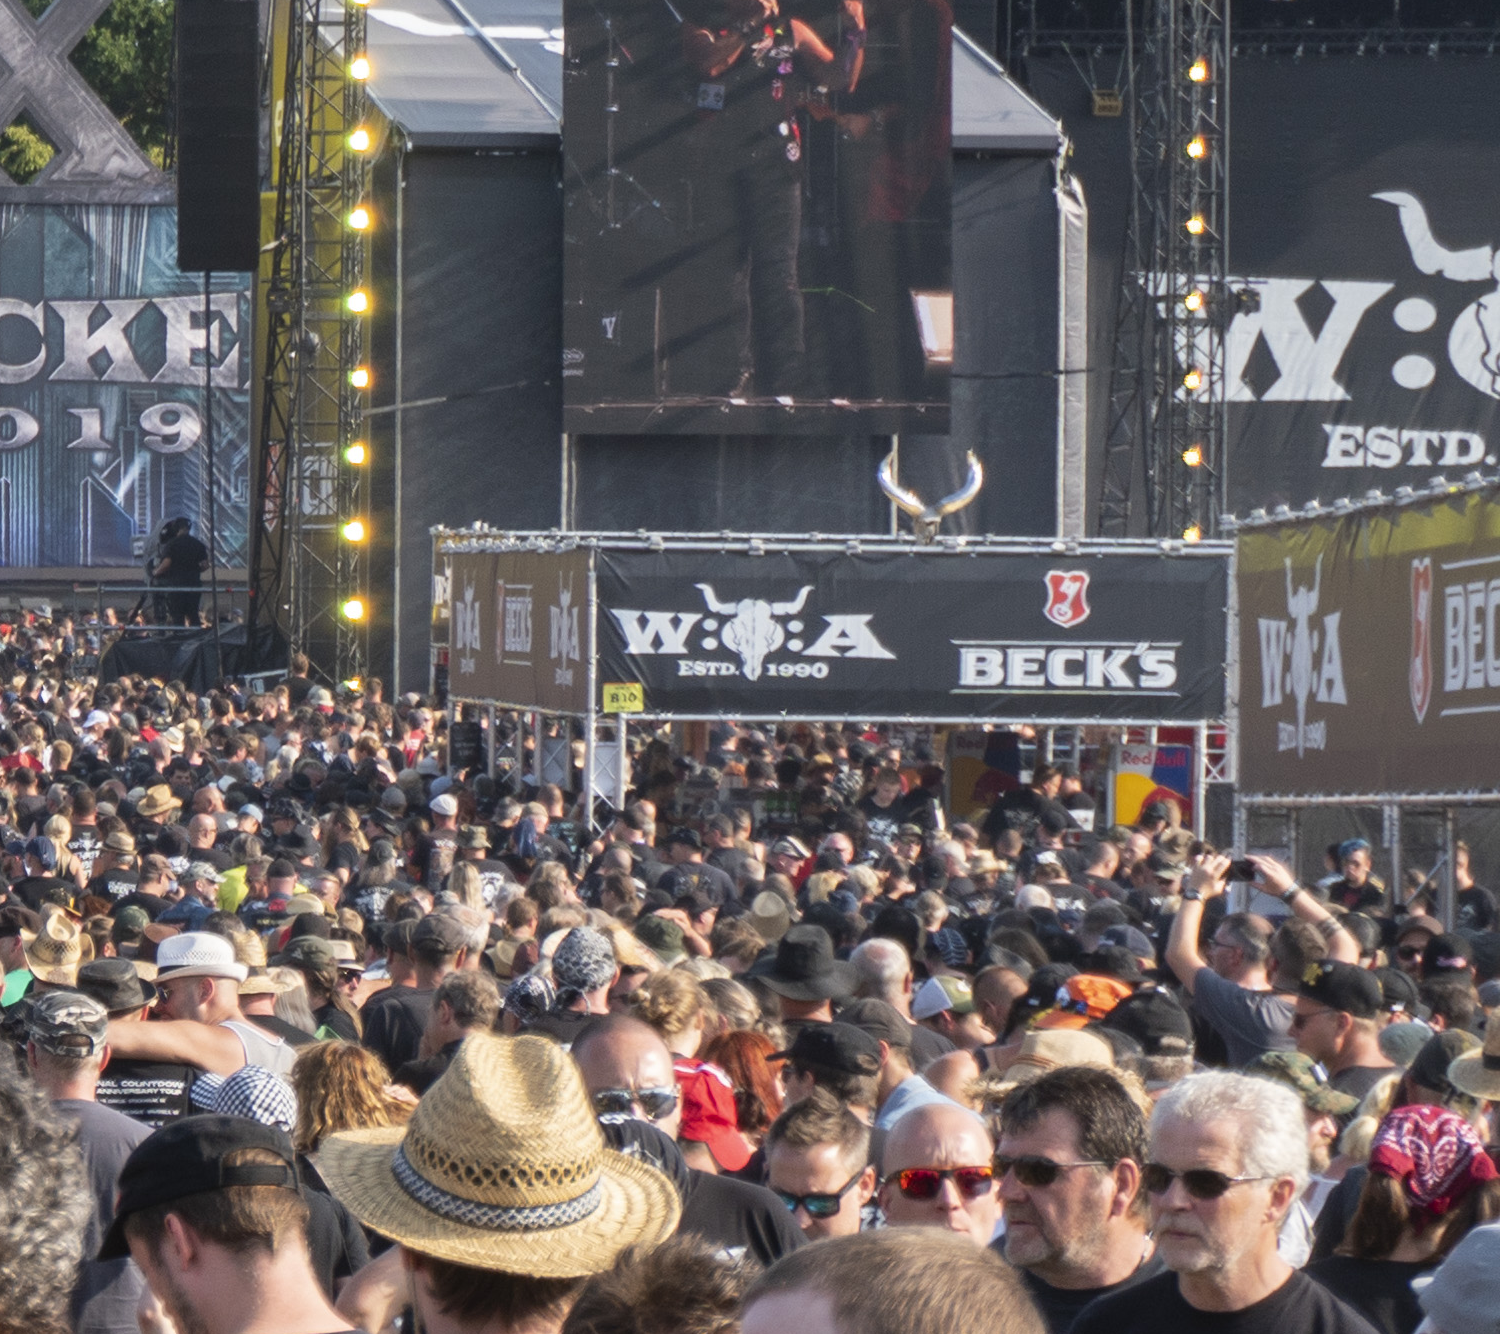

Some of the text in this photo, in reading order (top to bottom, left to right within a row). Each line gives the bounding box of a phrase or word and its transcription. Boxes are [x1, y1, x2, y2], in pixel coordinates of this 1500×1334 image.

[1321, 423, 1498, 468] ESTD.
[678, 658, 830, 679] ESTD. 1990
[958, 641, 1178, 688] BECK'S
[1120, 750, 1152, 767] Red
